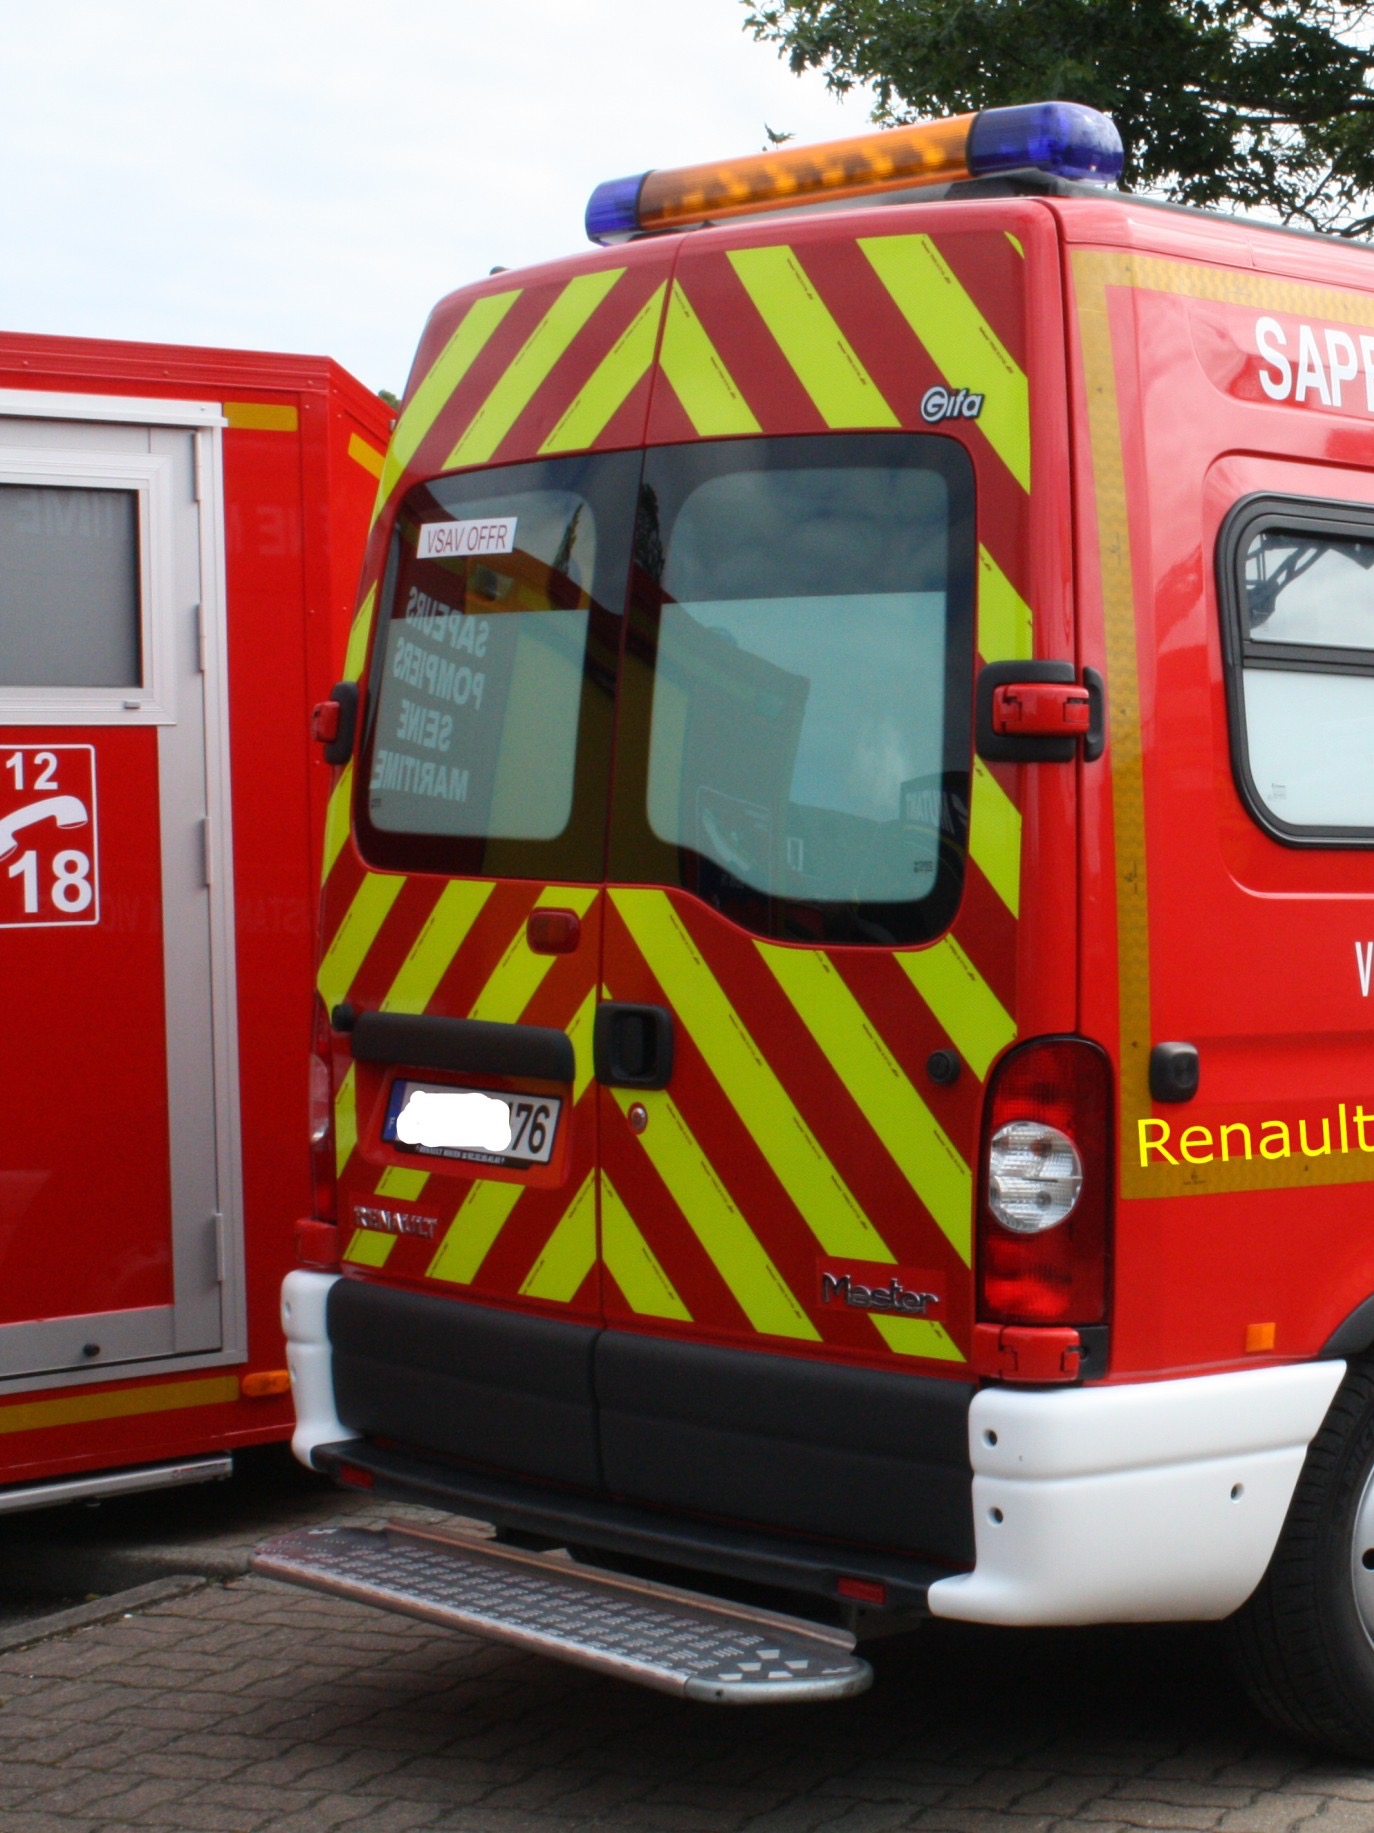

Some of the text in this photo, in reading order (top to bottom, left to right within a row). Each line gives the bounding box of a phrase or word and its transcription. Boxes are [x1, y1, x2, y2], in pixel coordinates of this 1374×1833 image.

[921, 386, 983, 423] Gifa
[427, 524, 507, 554] VSAV OFFR
[9, 850, 92, 913] 18
[354, 1205, 438, 1238] RENAULT
[823, 1272, 939, 1313] Master
